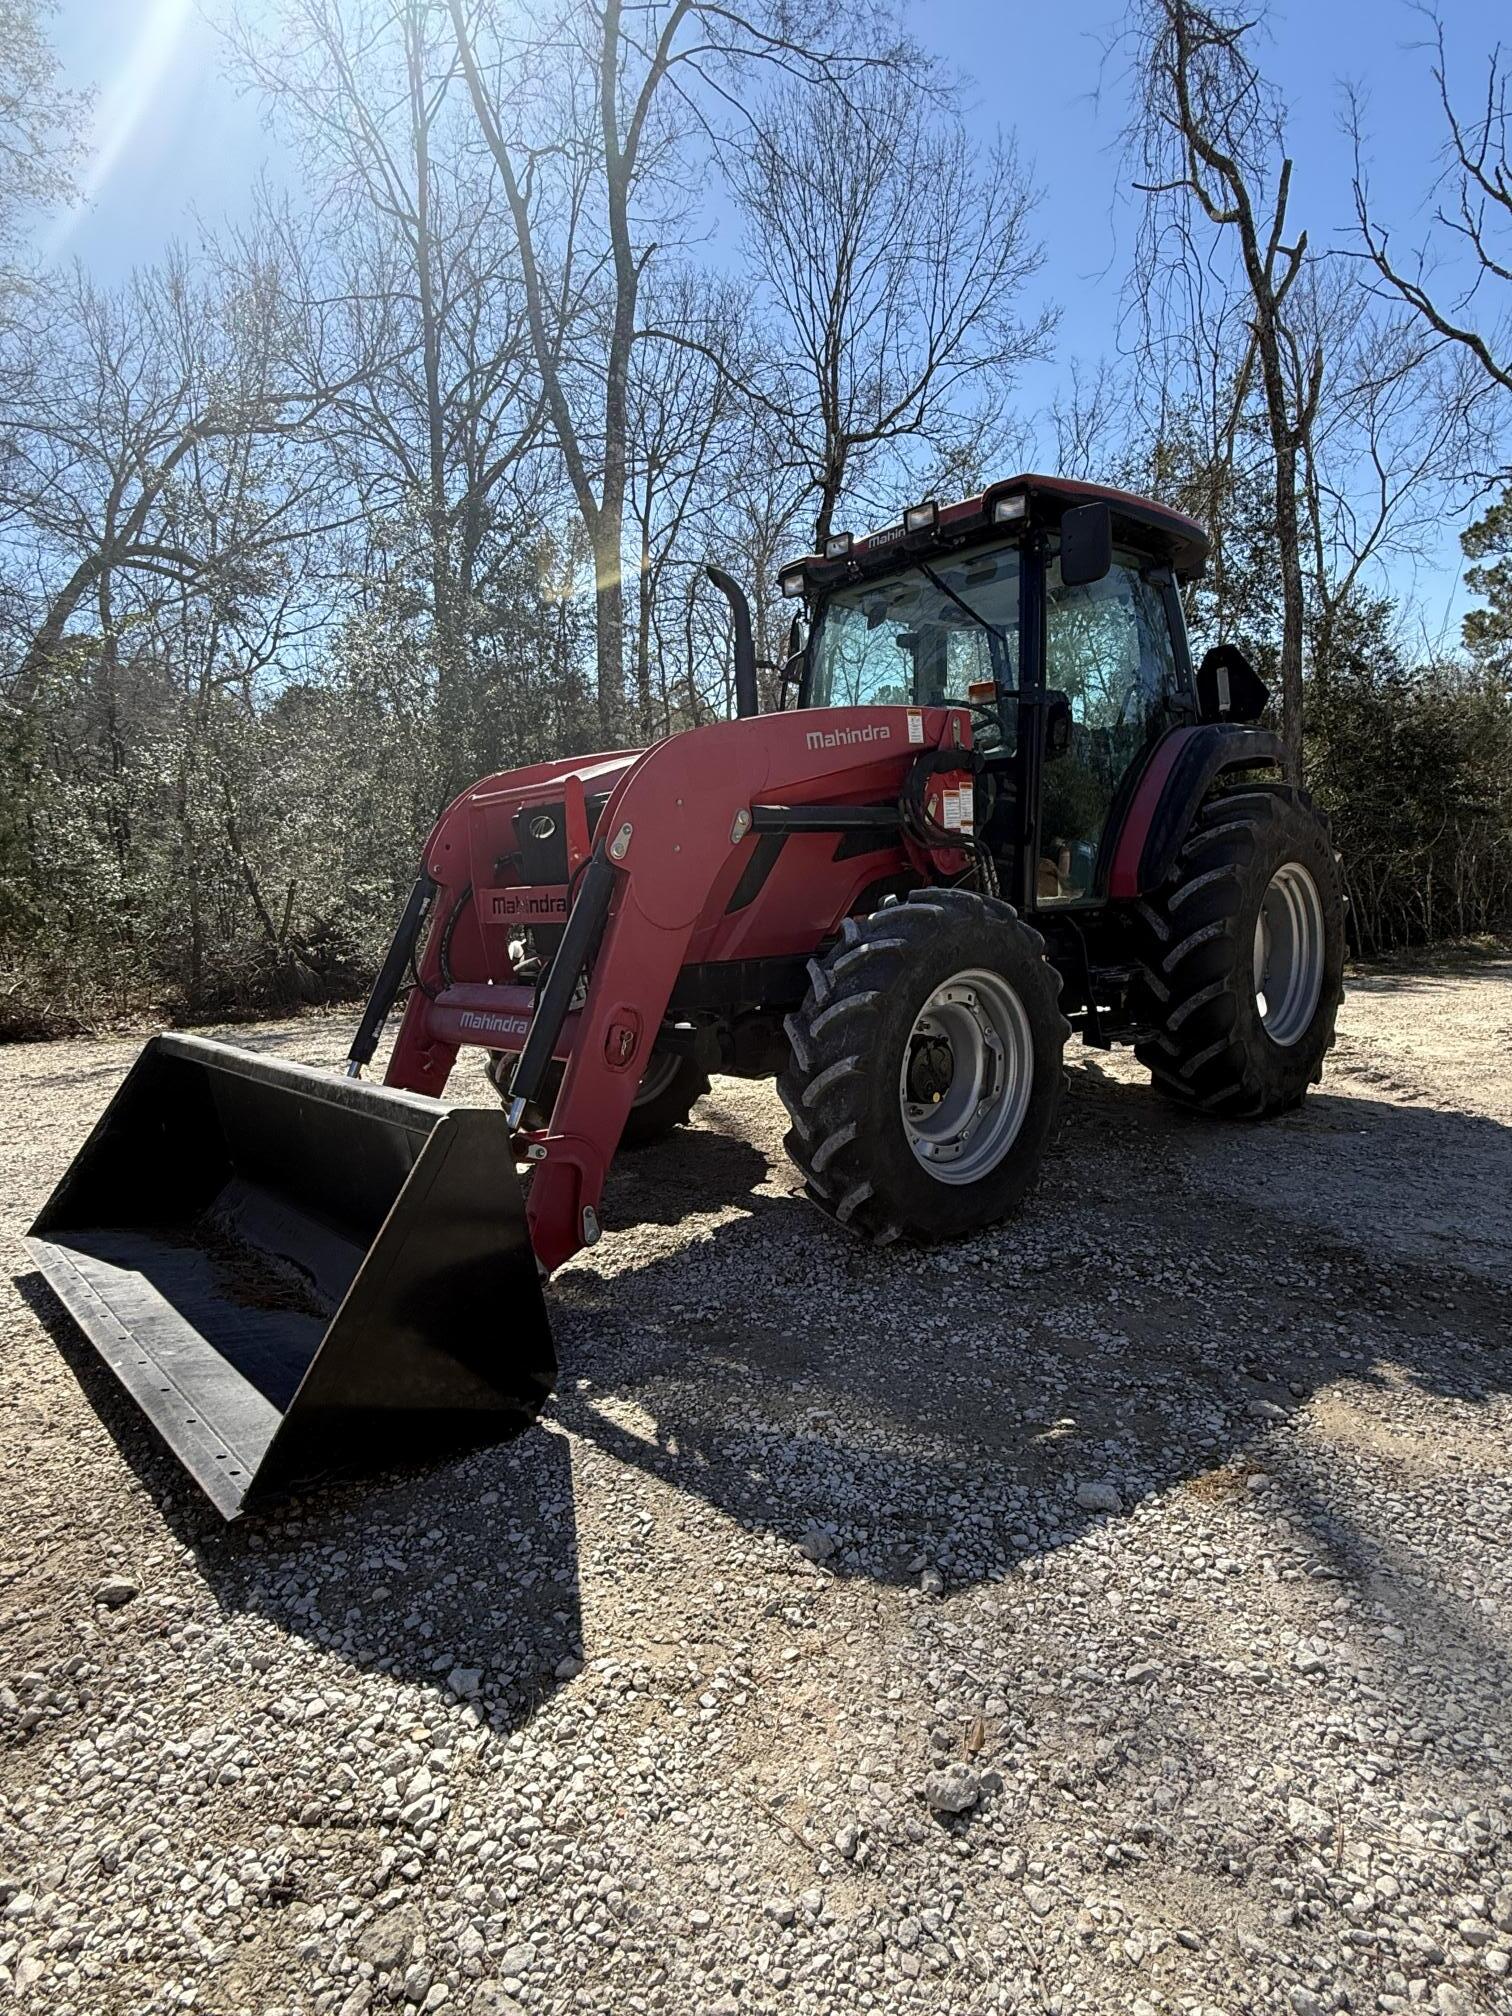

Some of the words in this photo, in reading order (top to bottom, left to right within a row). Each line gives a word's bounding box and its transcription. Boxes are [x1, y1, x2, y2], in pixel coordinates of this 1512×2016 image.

[868, 528, 906, 549] Mahin
[806, 724, 891, 750] Mahindra
[492, 893, 567, 914] Mahndra
[460, 1011, 528, 1034] Mahindra
